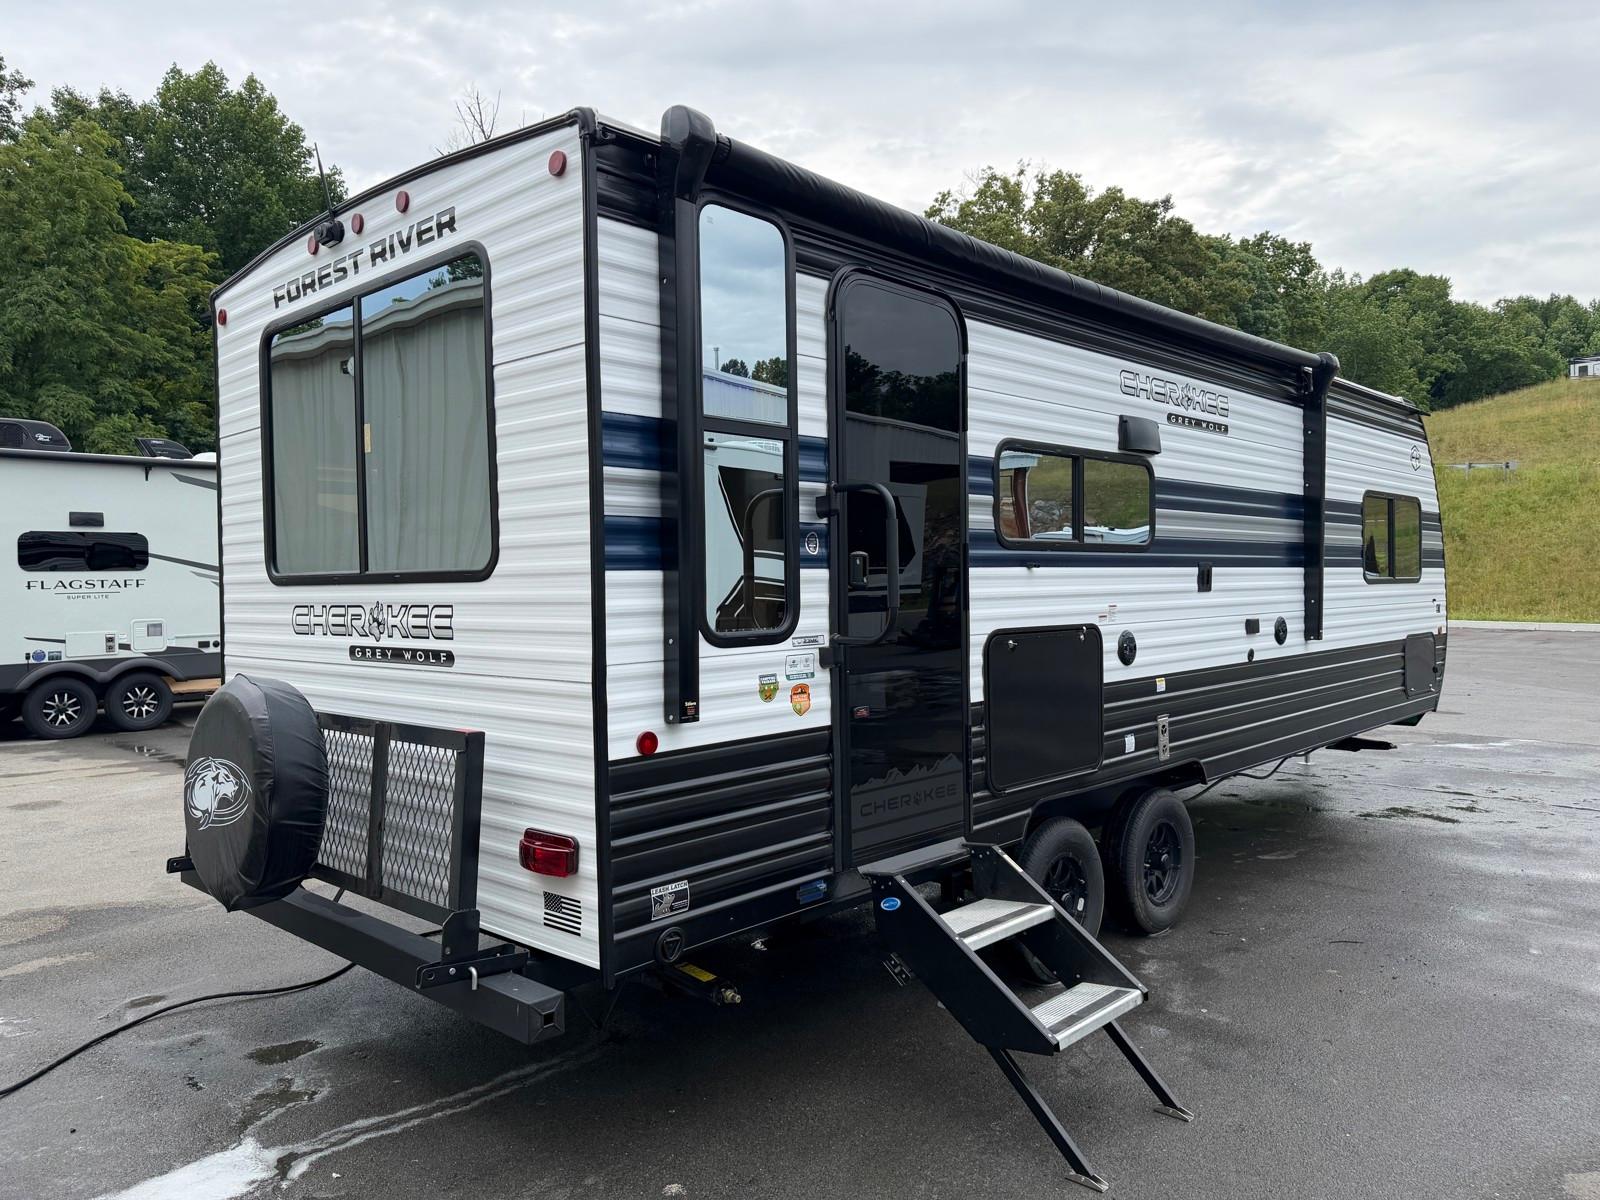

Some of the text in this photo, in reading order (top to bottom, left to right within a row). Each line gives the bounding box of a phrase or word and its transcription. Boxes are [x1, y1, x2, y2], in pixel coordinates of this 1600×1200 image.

[272, 206, 457, 309] FOREST RIVER
[1170, 415, 1227, 432] GREY WOLF
[25, 579, 146, 590] FLAGSTAFF
[354, 647, 447, 664] GREY WOLF
[651, 881, 688, 895] LEASH LATCH
